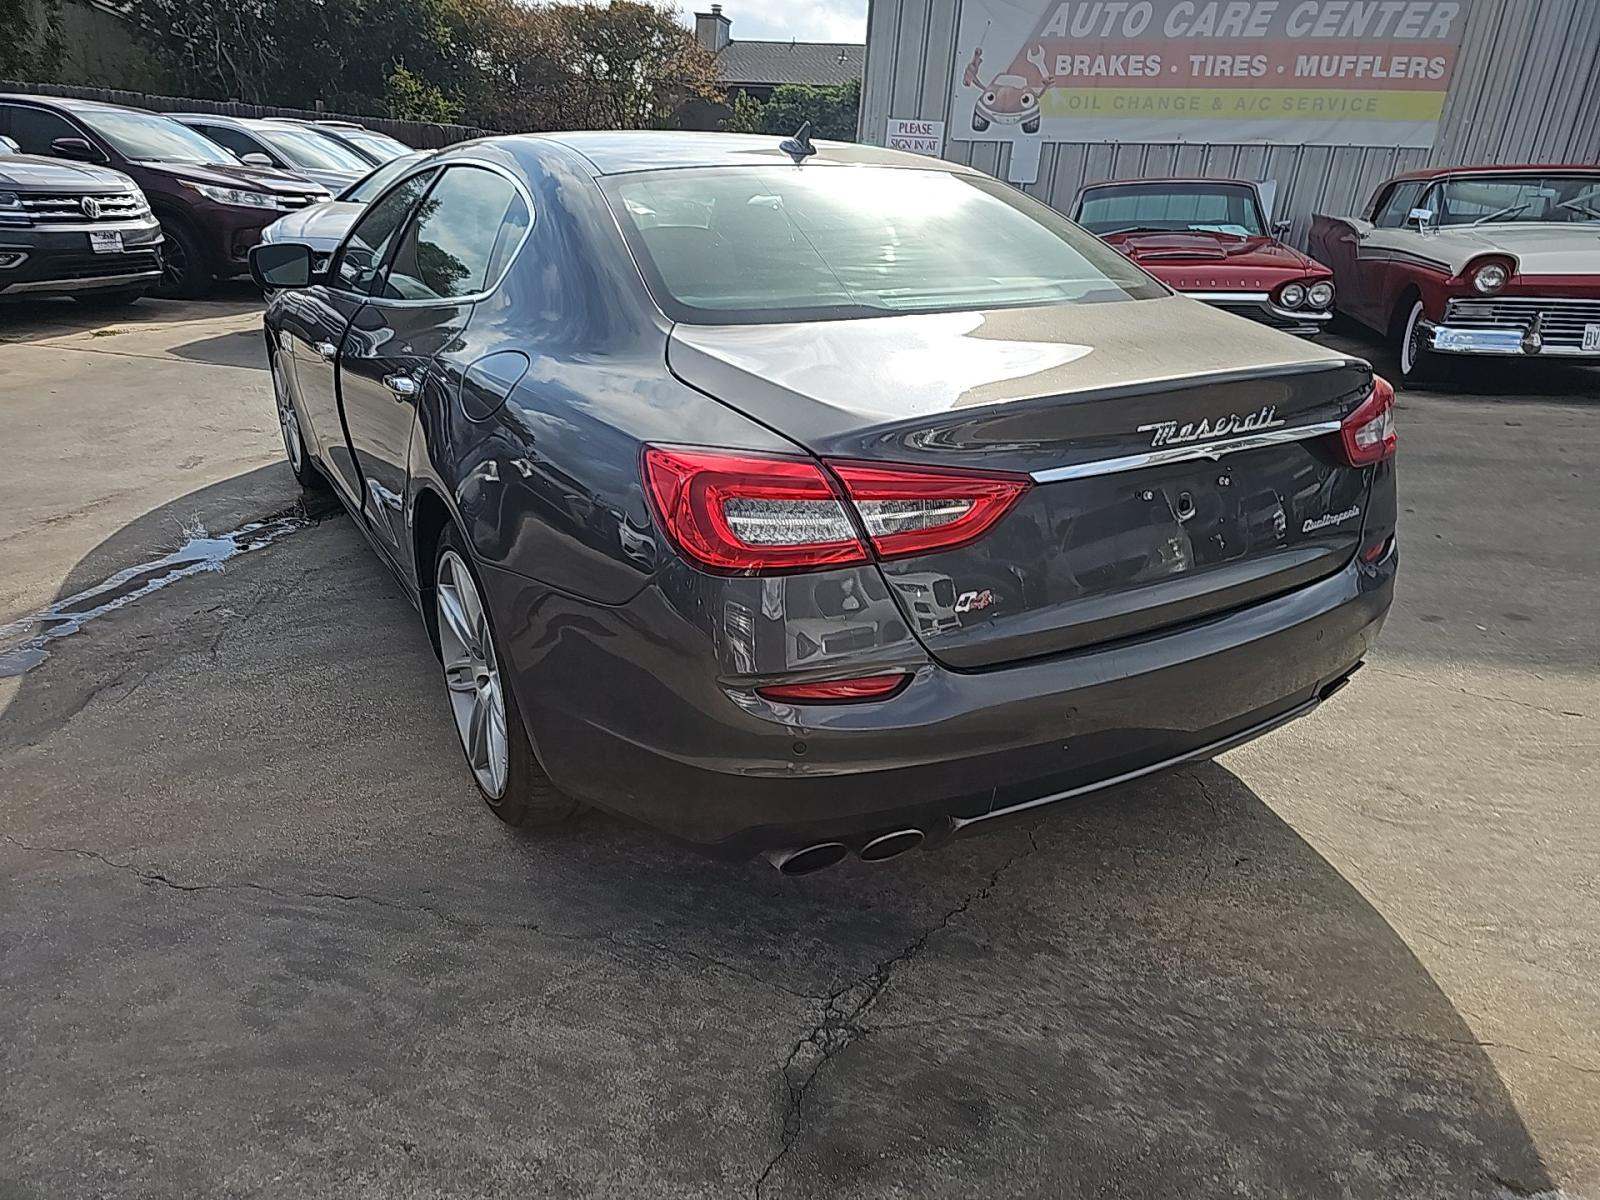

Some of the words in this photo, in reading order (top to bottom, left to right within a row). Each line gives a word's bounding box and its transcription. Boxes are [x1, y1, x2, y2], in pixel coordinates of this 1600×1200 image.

[1041, 1, 1153, 38] AUTO
[1163, 1, 1279, 38] CARE
[1285, 1, 1460, 39] CENTER
[1055, 54, 1161, 77] BRAKES
[1189, 54, 1268, 78] TIRES
[1294, 54, 1447, 80] MUFFLERS
[1069, 95, 1101, 110] OIL
[1113, 95, 1201, 111] CHANGE
[1211, 96, 1224, 111] &
[1234, 96, 1273, 111] A/C
[1281, 96, 1379, 112] SERVICE
[899, 122, 933, 135] PLEASE
[891, 138, 912, 150] SIGN
[914, 139, 924, 150] IN
[926, 140, 938, 151] AT
[1137, 405, 1285, 447] Maserati
[954, 589, 993, 613] Q4
